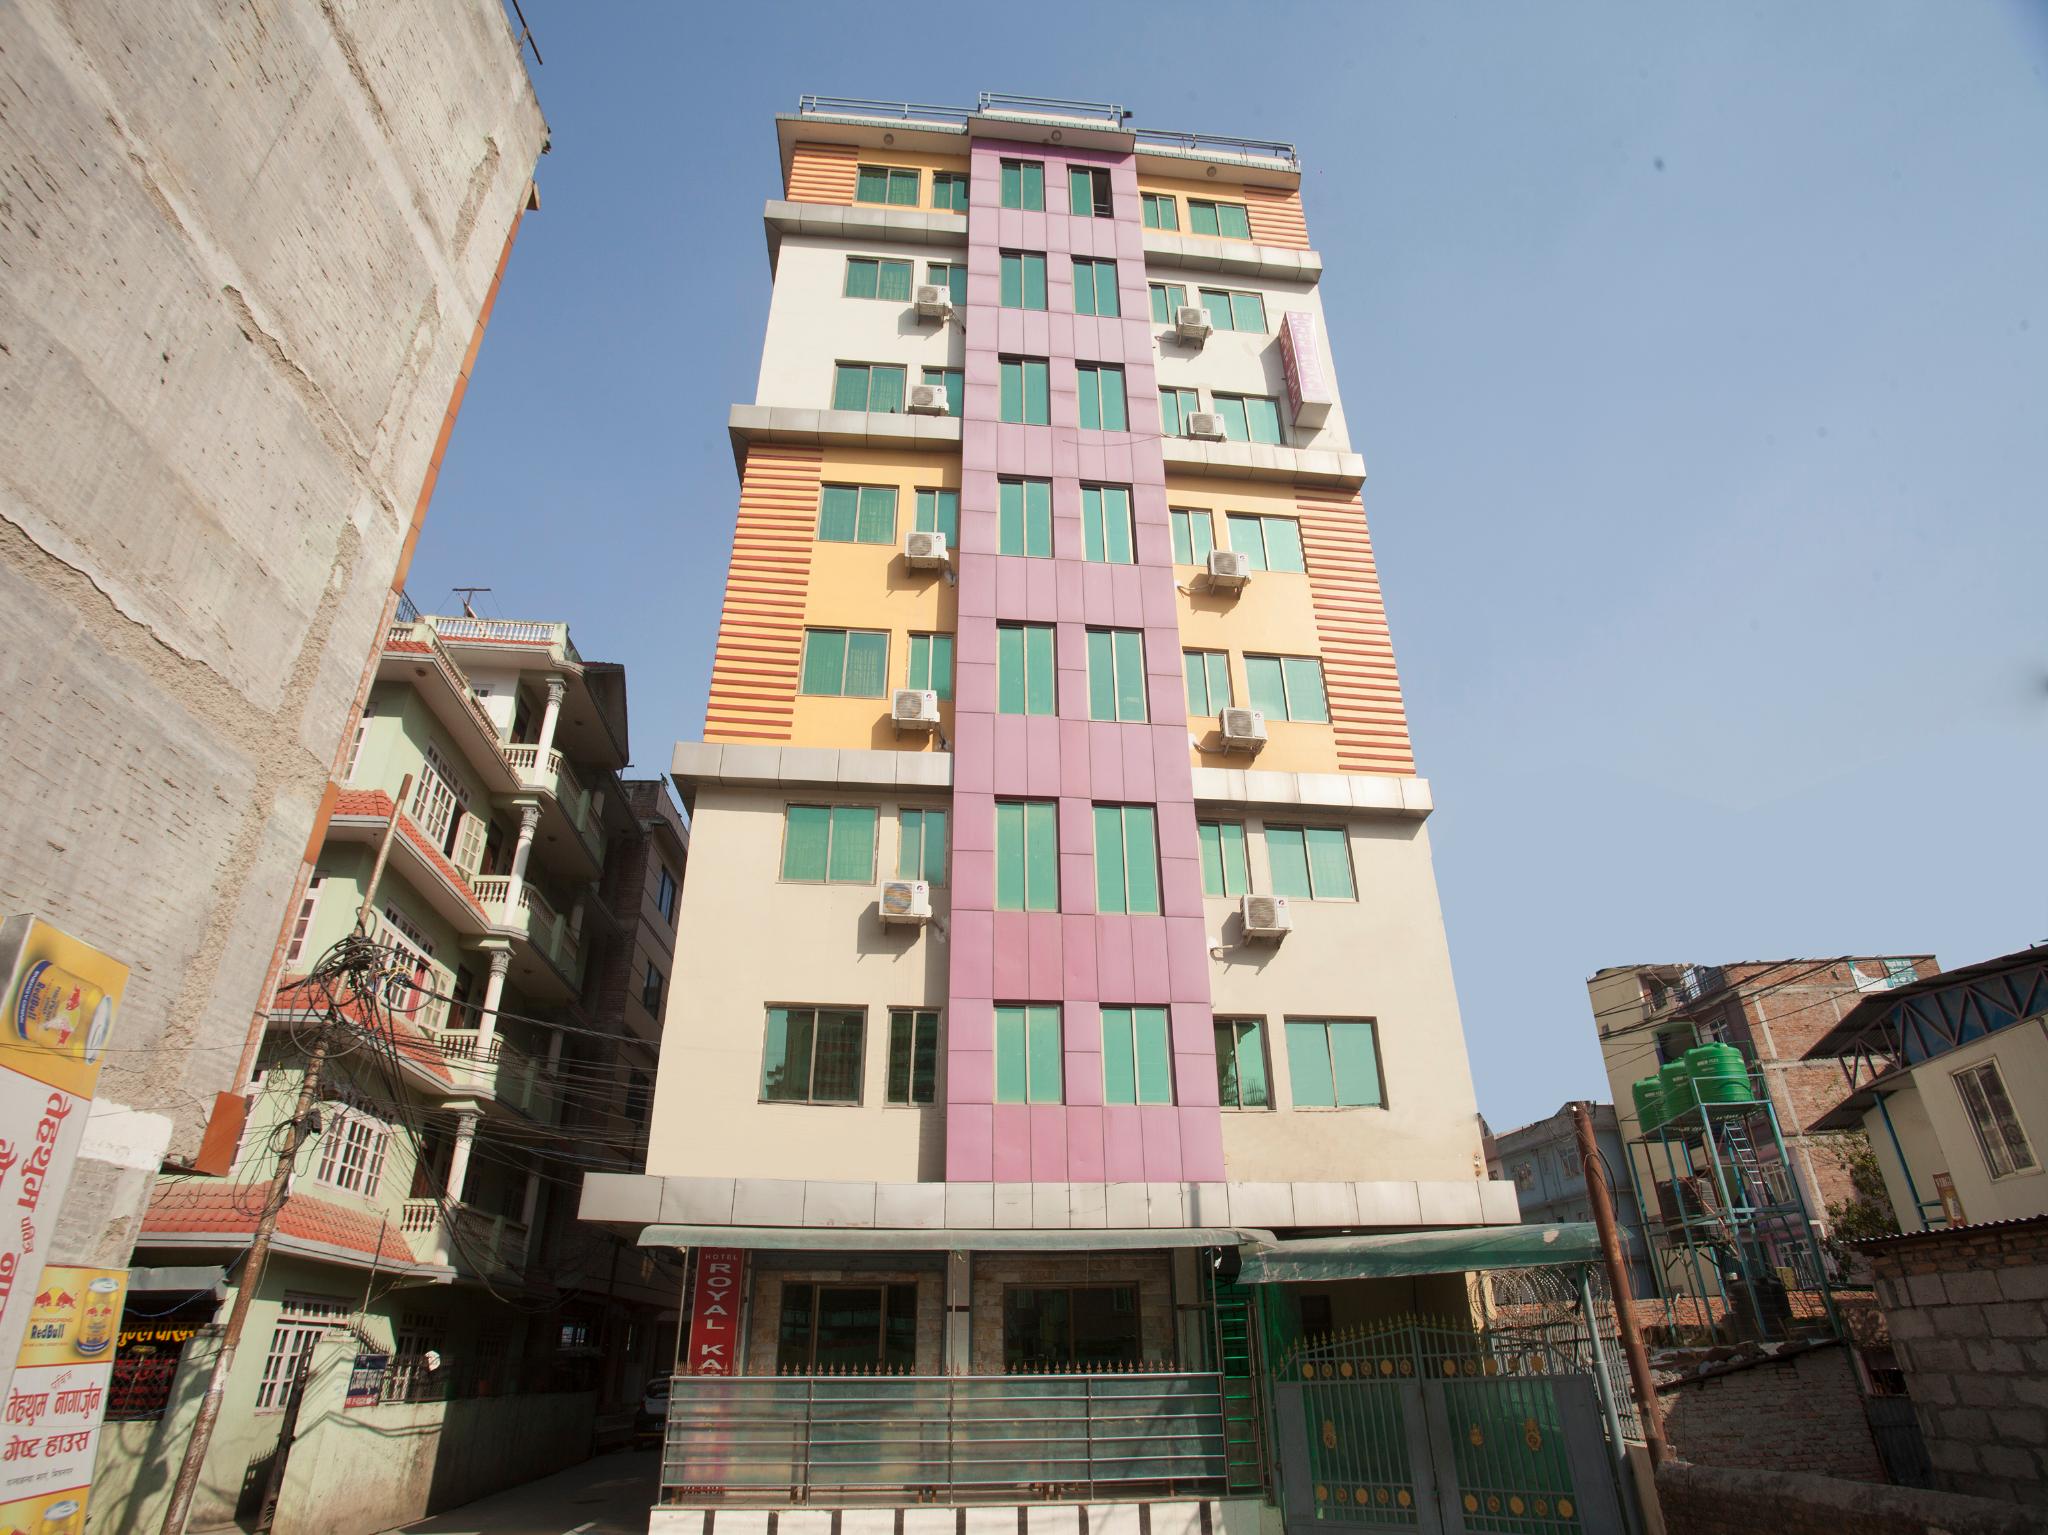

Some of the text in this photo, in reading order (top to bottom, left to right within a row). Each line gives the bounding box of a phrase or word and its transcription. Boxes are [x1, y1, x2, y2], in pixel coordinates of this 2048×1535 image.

[705, 1253, 738, 1261] HOTEL
[704, 1263, 732, 1330] ROYAL
[45, 1431, 91, 1458] हाउस
